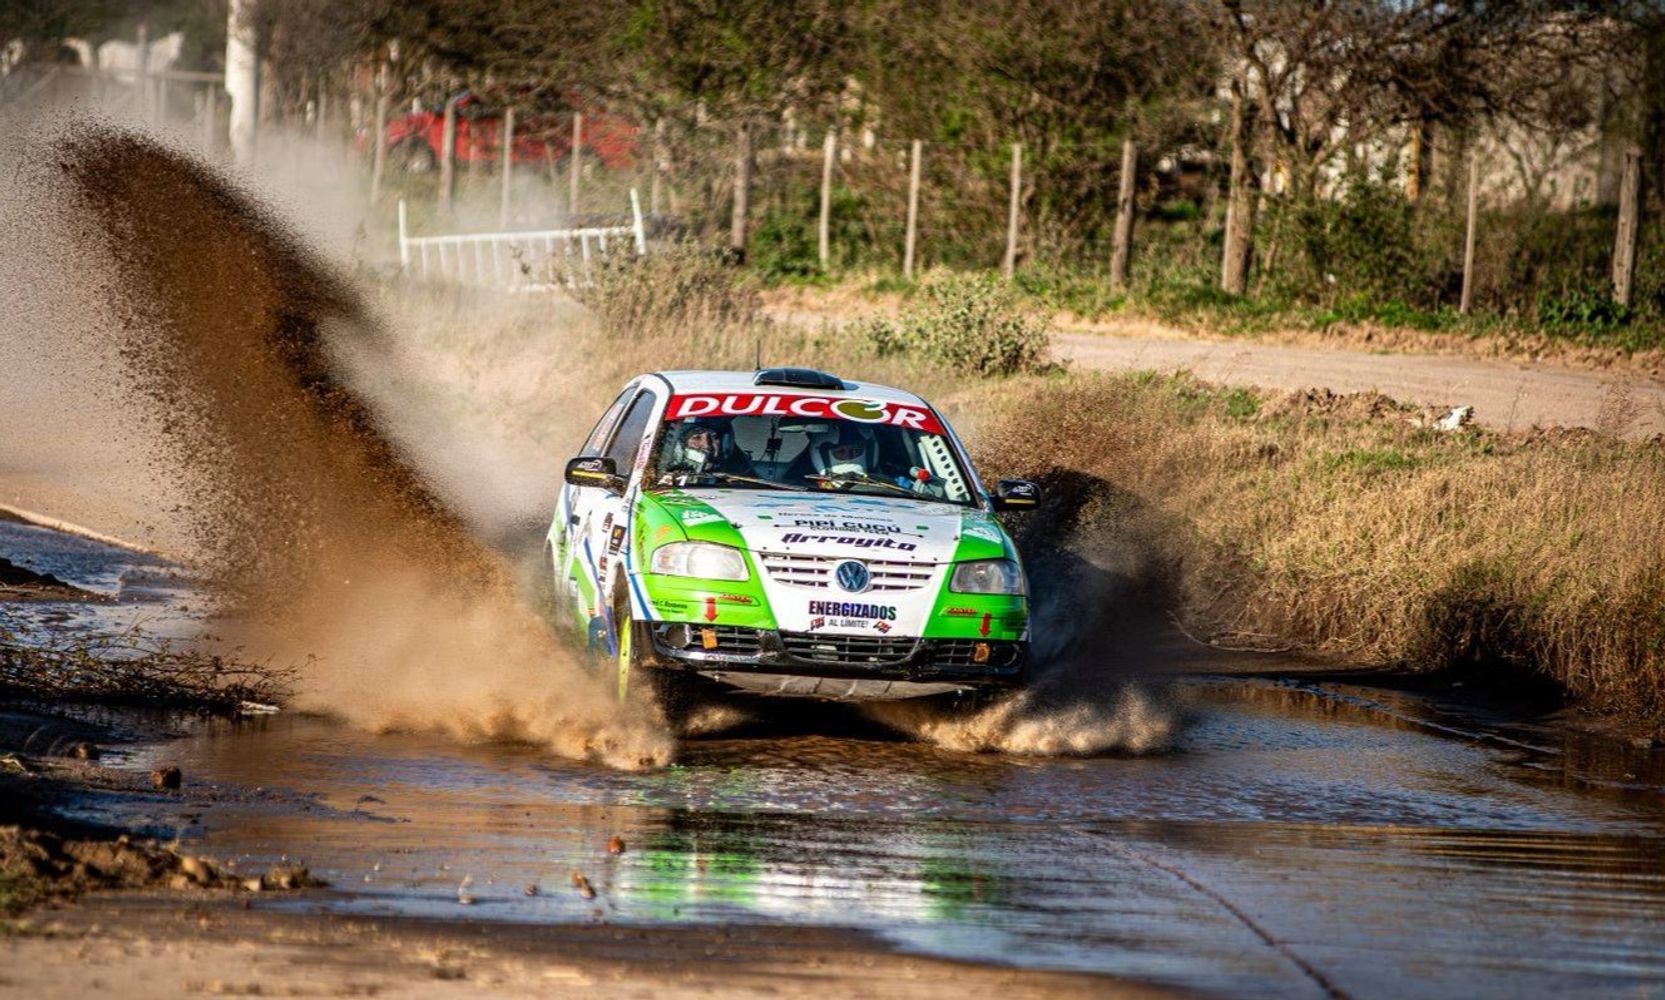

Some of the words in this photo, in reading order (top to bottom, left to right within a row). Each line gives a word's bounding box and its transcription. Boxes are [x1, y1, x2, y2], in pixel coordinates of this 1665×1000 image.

[676, 395, 928, 430] DULCOR
[782, 533, 917, 551] Arroyito
[808, 600, 897, 620] ENERGIZADOS
[828, 619, 838, 627] AL
